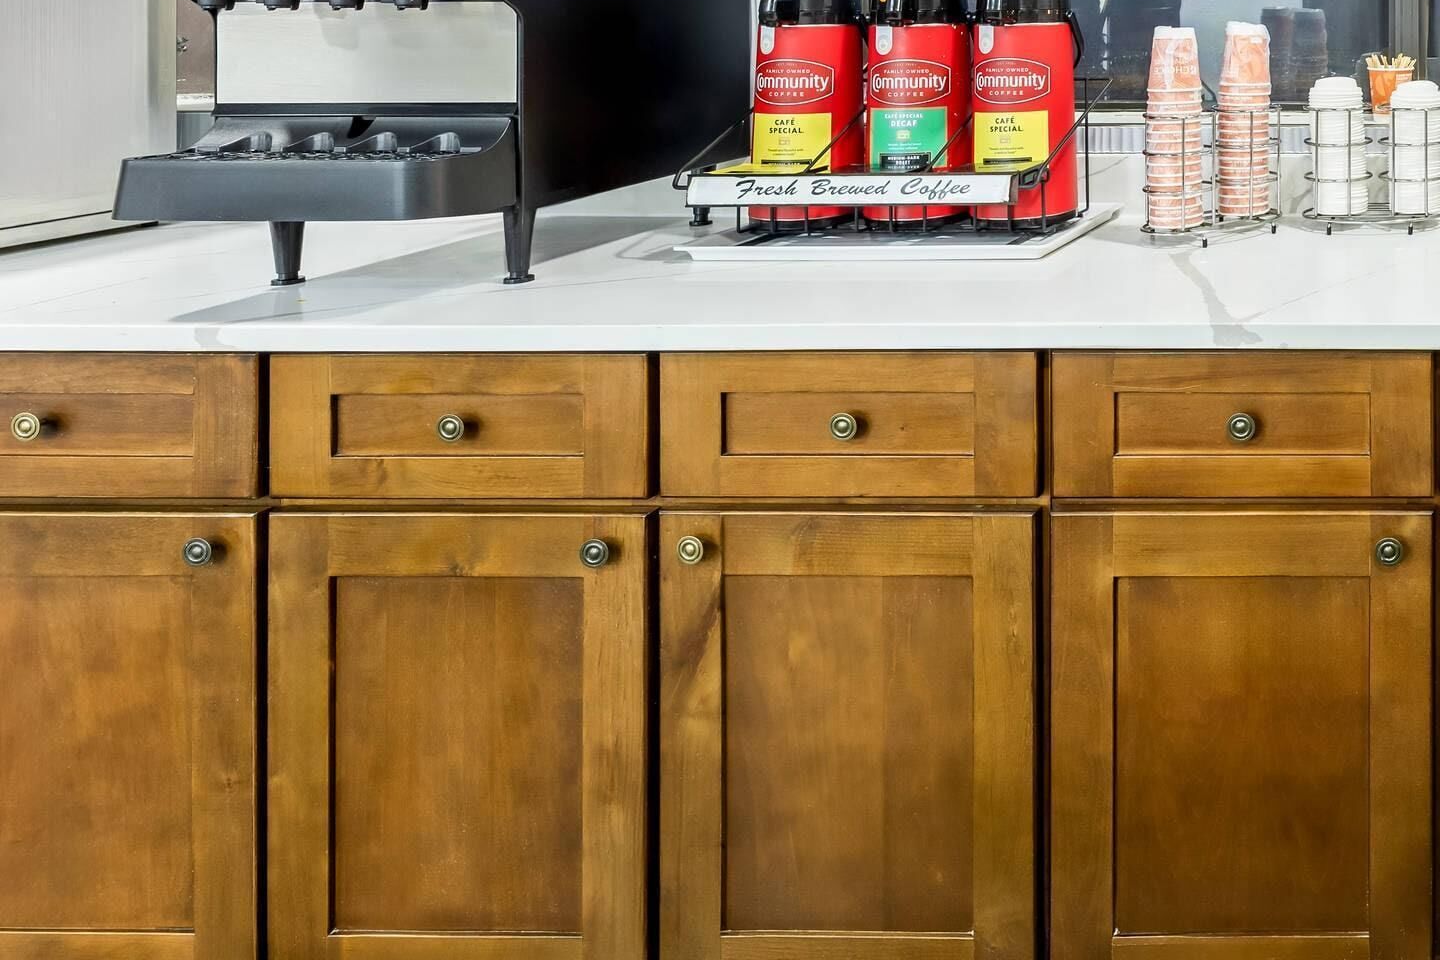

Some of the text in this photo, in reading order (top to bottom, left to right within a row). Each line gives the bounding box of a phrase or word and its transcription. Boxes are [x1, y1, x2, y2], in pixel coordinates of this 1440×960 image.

[756, 72, 830, 92] Community
[872, 73, 947, 93] Community
[976, 71, 1046, 91] Community
[774, 117, 795, 126] CAFÉ
[995, 116, 1015, 124] CAFÉ
[735, 177, 971, 201] Fresh Brewed Coffee
